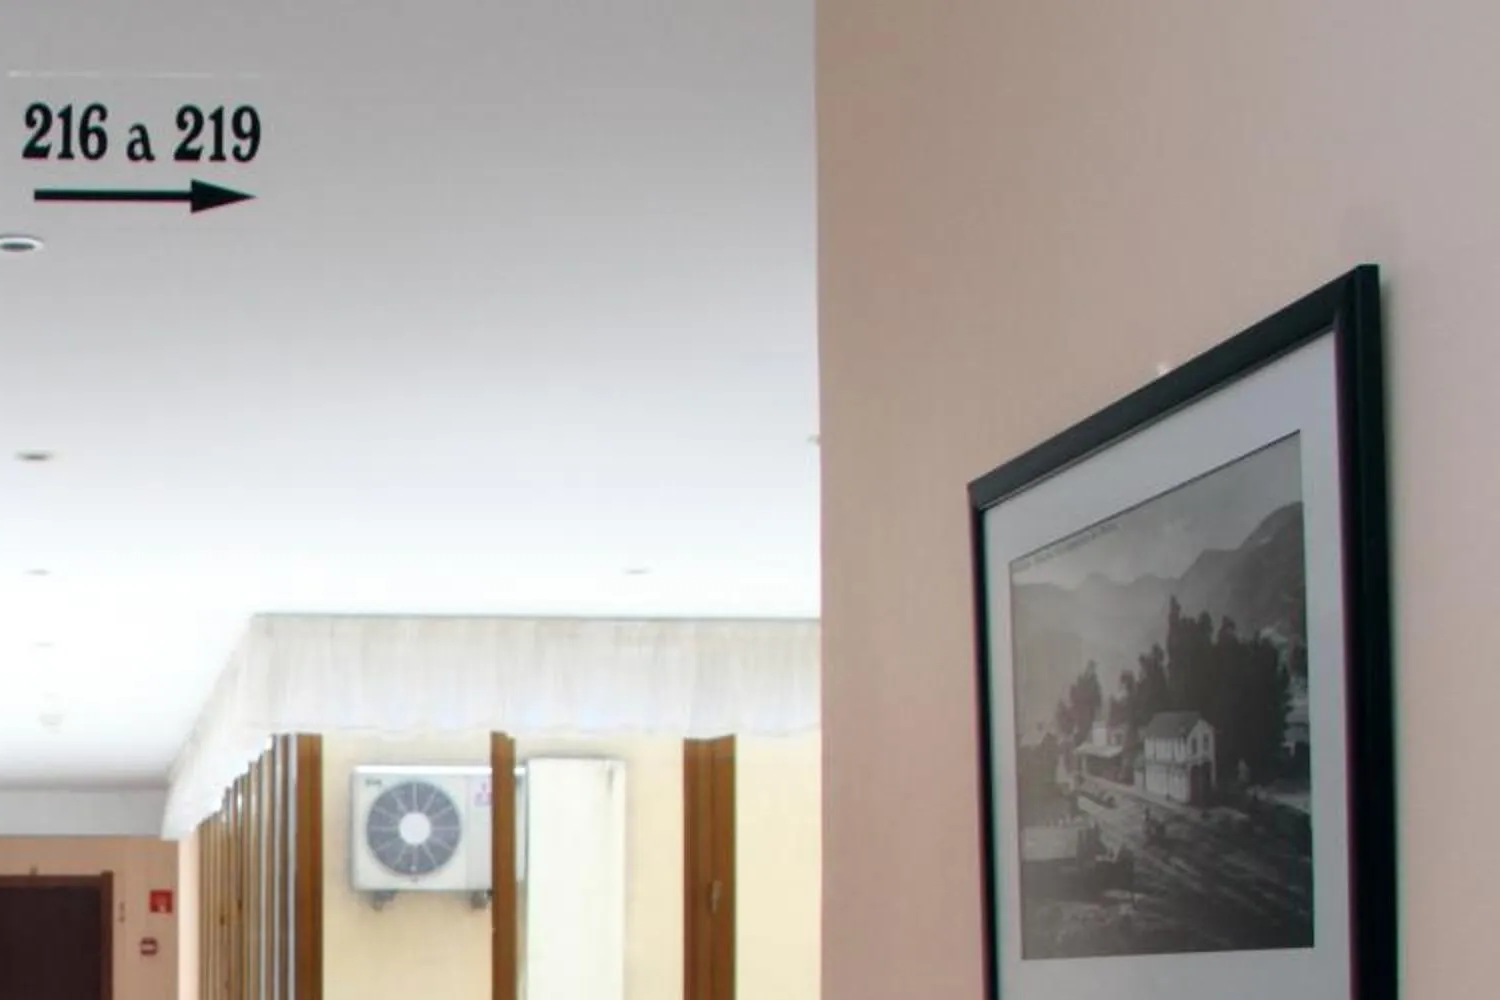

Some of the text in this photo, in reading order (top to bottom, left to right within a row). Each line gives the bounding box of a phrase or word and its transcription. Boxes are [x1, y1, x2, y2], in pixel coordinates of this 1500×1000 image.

[22, 102, 261, 163] 216 a 219
